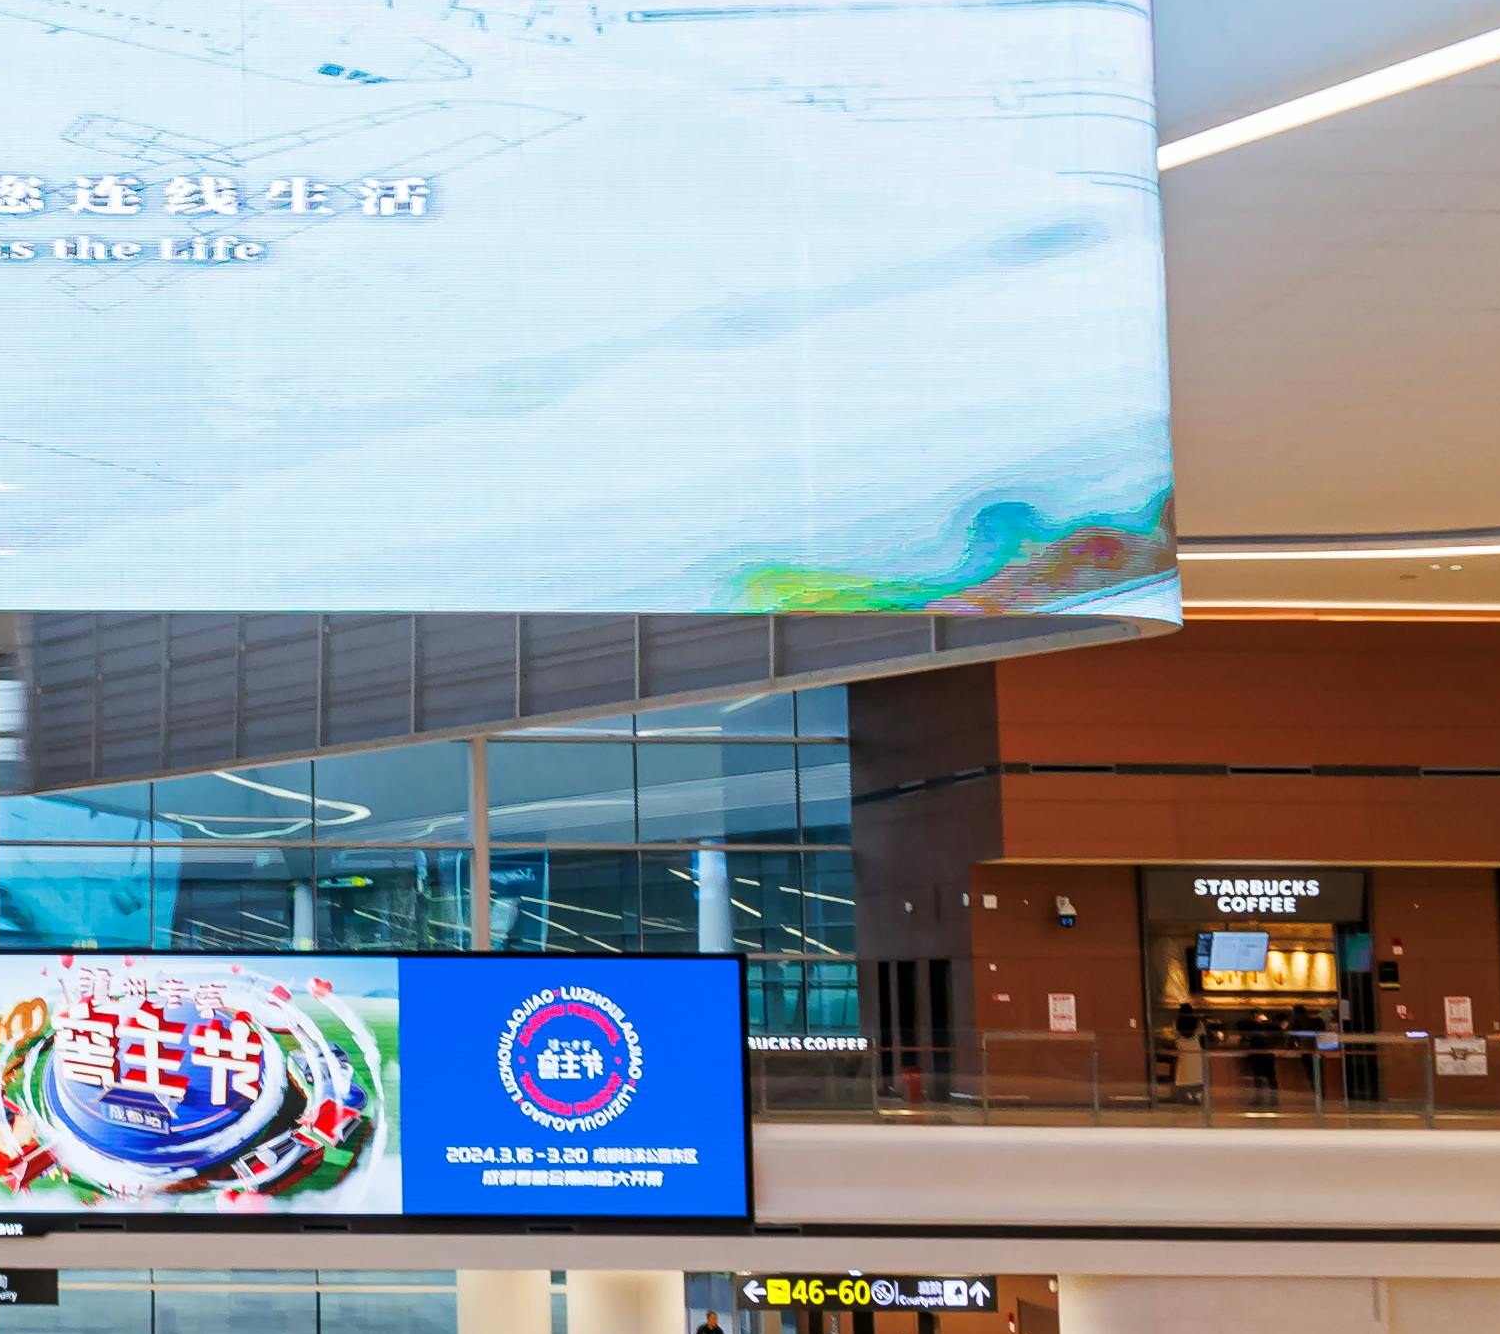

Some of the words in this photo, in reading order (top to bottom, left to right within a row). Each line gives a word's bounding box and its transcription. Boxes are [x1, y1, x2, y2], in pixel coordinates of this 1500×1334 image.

[51, 231, 138, 263] the
[154, 231, 263, 263] Life
[1193, 878, 1320, 897] STARBUCKS
[1216, 896, 1297, 914] COFFEE
[803, 1036, 868, 1051] COFFEE
[791, 1279, 871, 1306] 46-60
[899, 1294, 943, 1308] Courtyard
